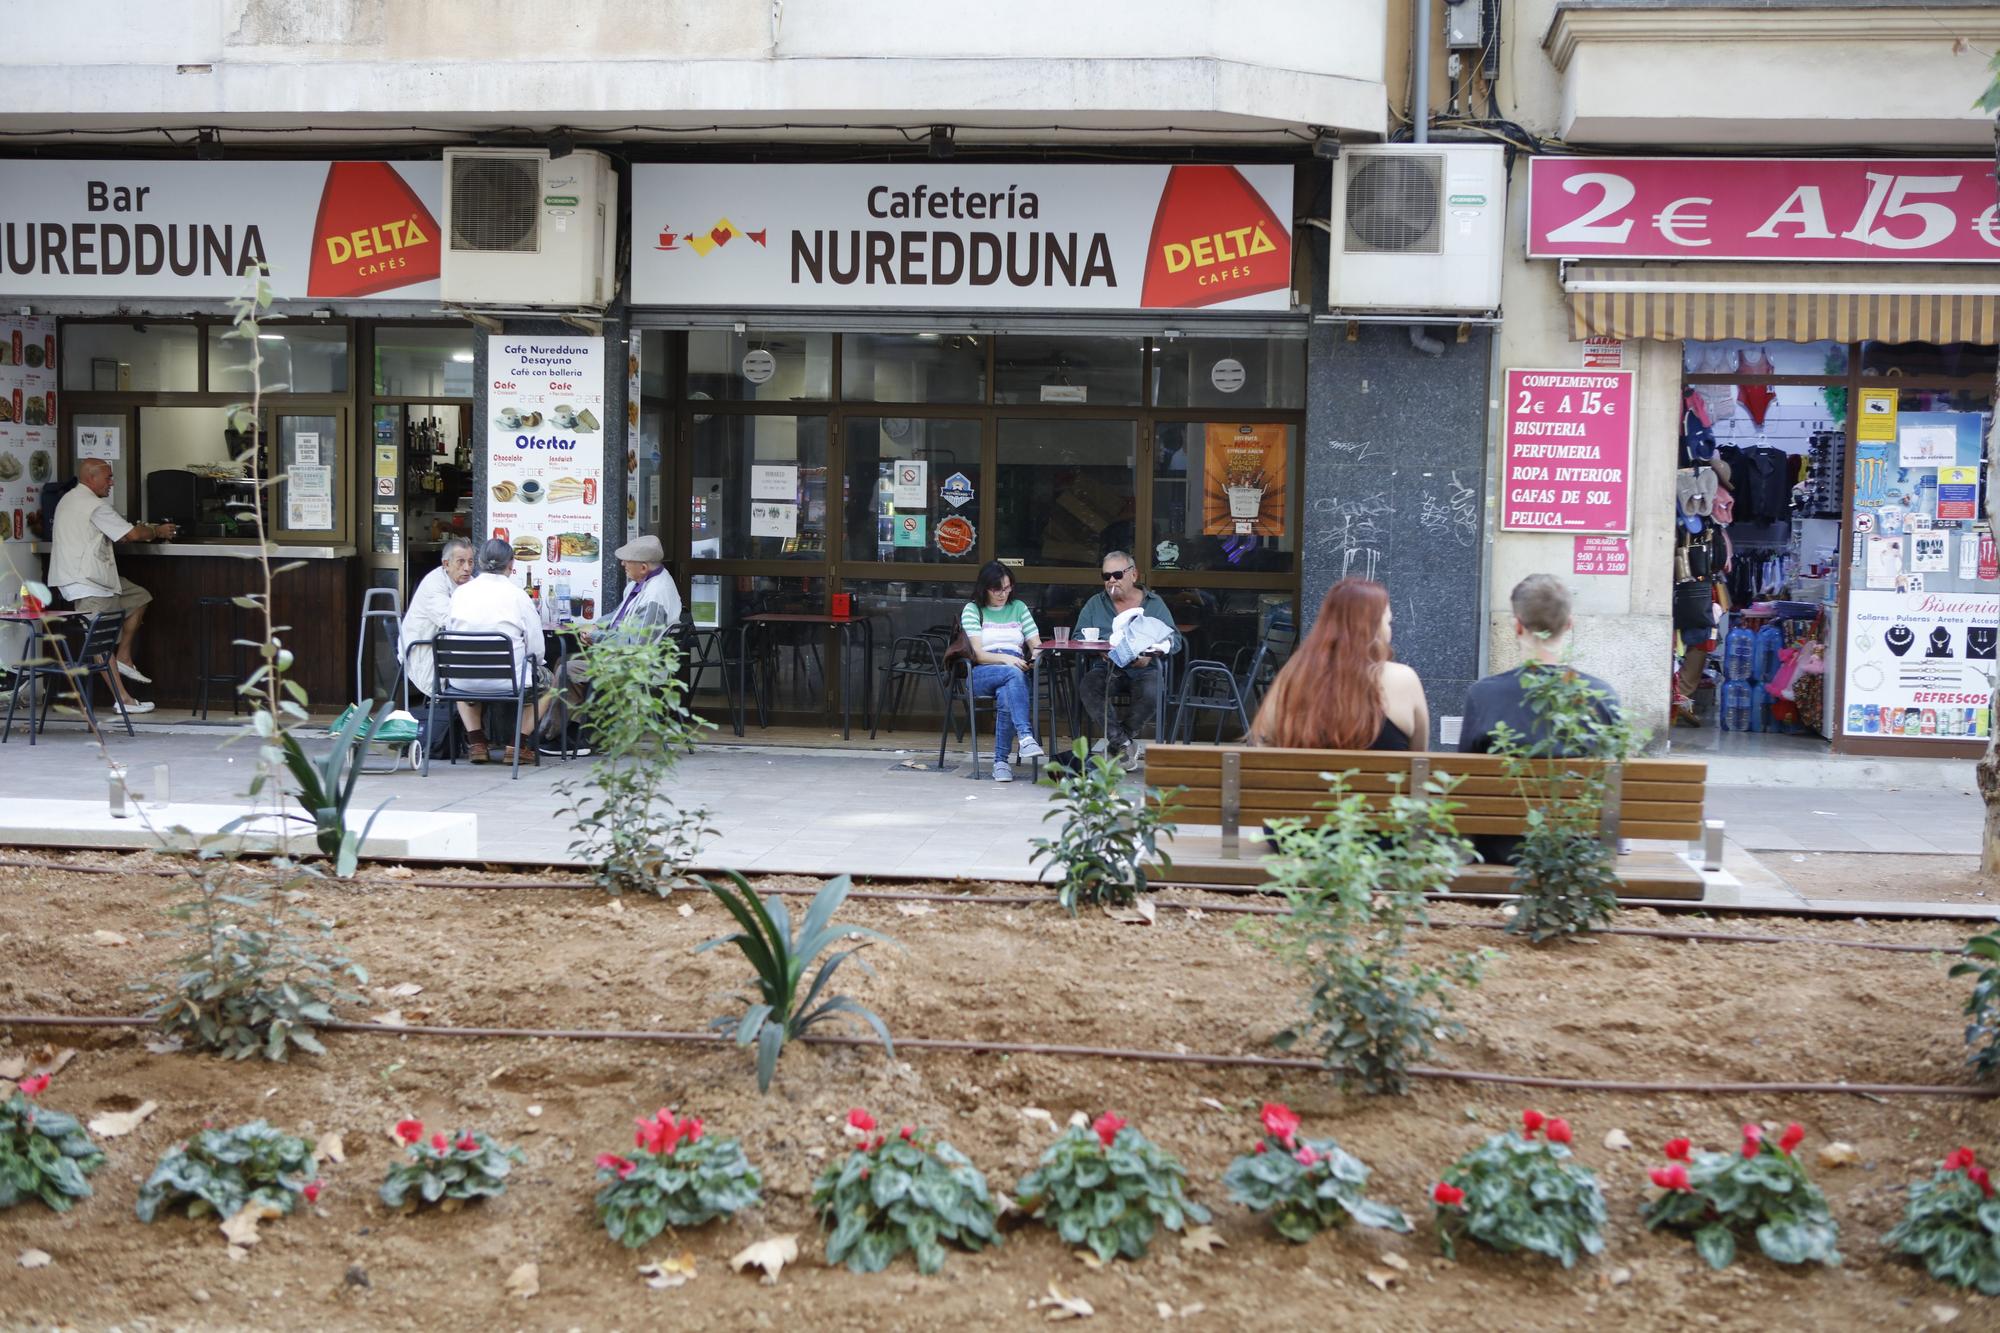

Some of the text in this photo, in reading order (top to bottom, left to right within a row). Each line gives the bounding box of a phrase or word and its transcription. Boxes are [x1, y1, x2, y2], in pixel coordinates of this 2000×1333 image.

[88, 181, 150, 212] Bar
[867, 184, 1038, 219] Cafetería
[1746, 185, 1836, 240] A
[0, 222, 271, 277] UREDDUNA
[326, 219, 430, 265] DELTA
[1163, 225, 1277, 274] DELTA
[791, 230, 1118, 288] NUREDDUNA
[530, 345, 589, 355] Nuredduna
[520, 356, 572, 366] Desayuno
[1522, 375, 1620, 389] COMPLEMENTOS
[1557, 395, 1572, 413] A
[1513, 421, 1587, 437] BISUTERIA
[515, 435, 577, 450] Ofertas
[1512, 444, 1601, 460] PERFUMERIA
[1512, 466, 1622, 483] ROPA INTERIOR
[1511, 488, 1612, 505] GAFAS DE SOL
[1896, 614, 1931, 623] Pulseras
[1913, 692, 1987, 705] REFRESCOS
